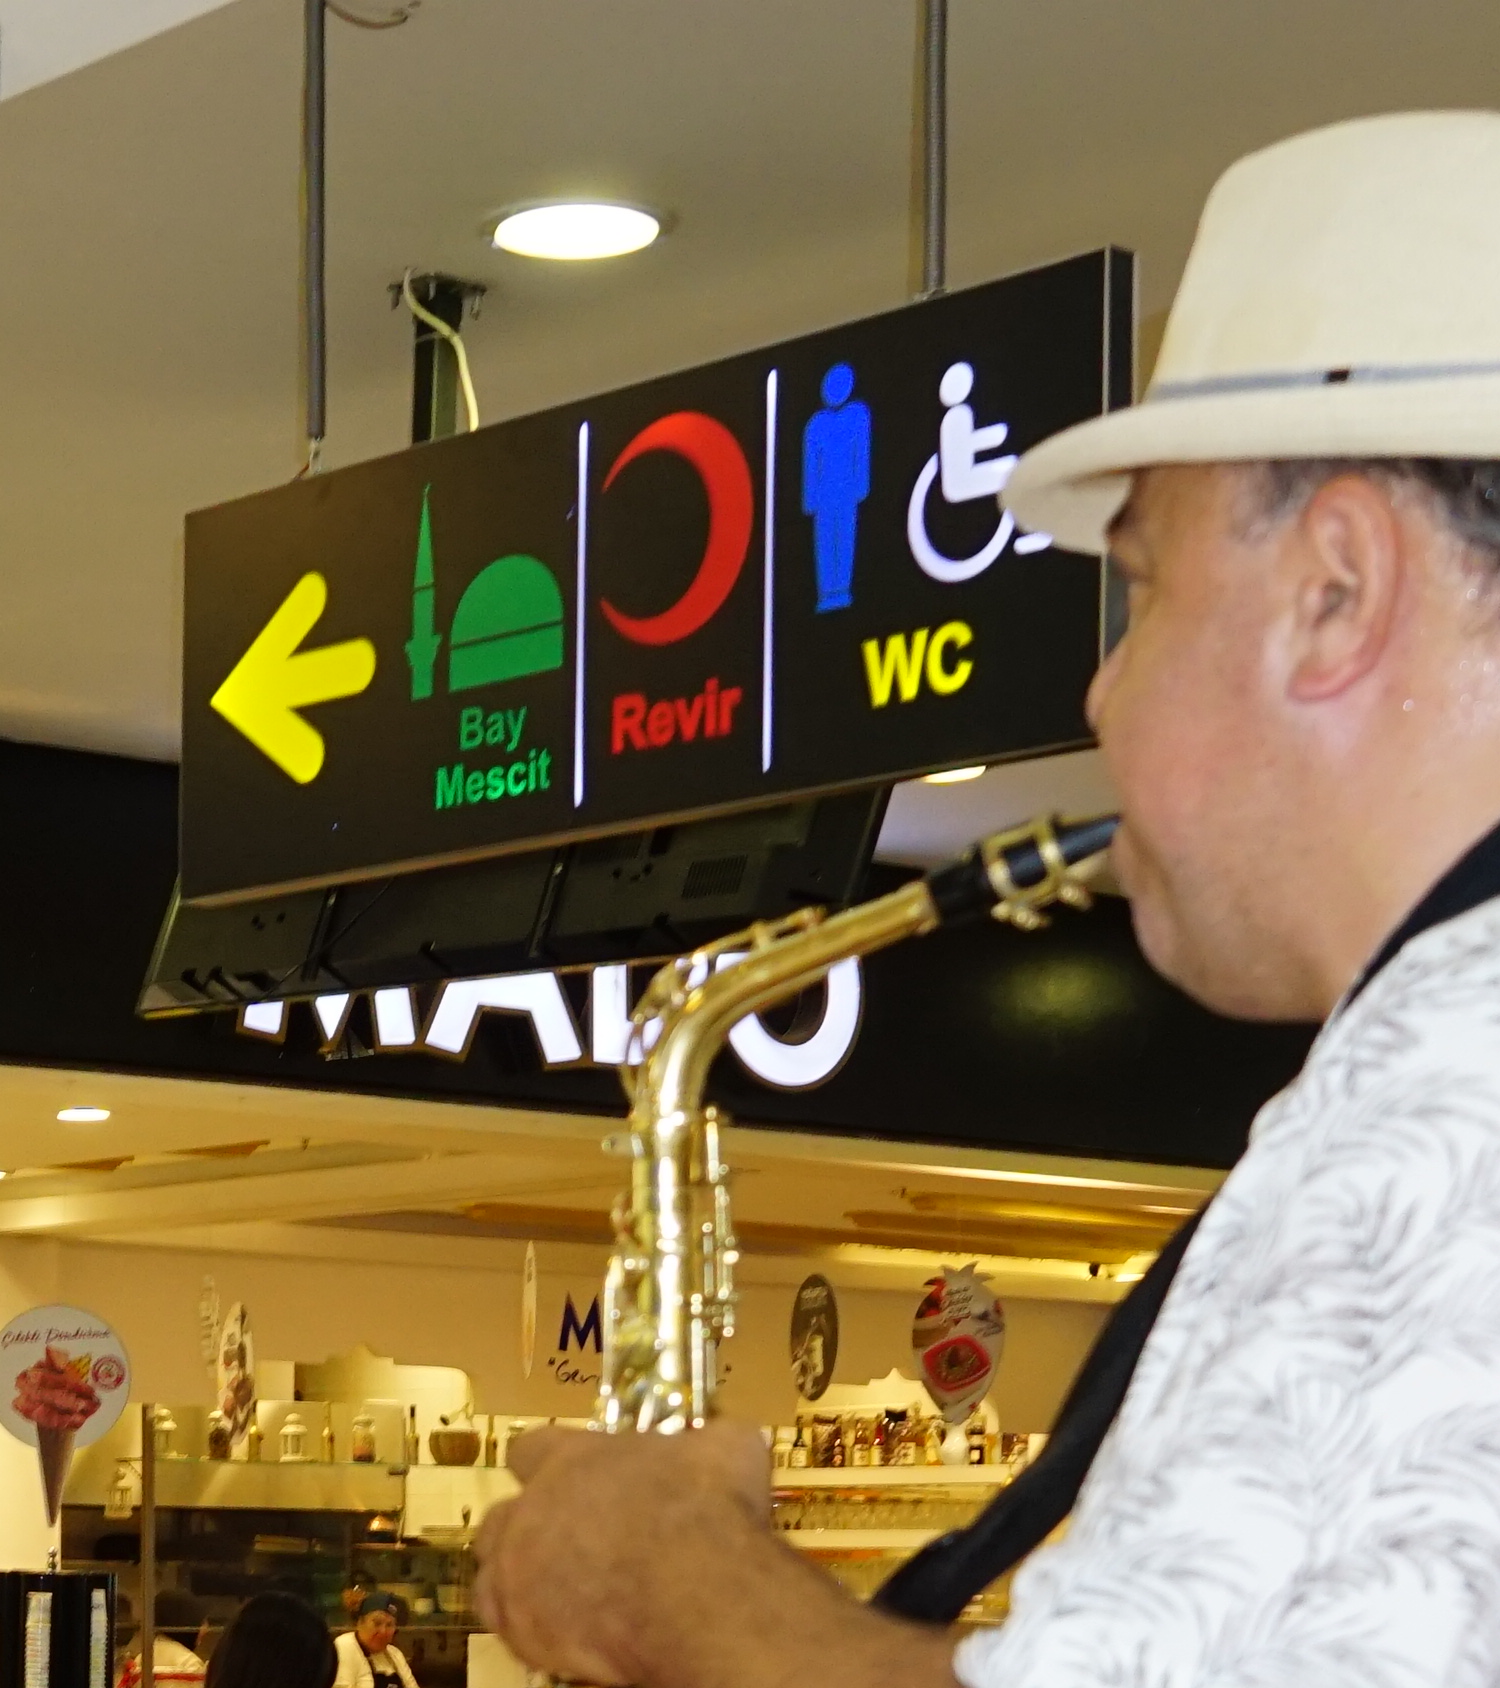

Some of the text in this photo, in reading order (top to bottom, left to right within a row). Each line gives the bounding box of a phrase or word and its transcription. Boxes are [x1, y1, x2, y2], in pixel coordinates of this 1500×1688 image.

[861, 620, 975, 709] WC
[459, 706, 528, 755] Bay
[610, 676, 743, 755] Revir
[434, 750, 552, 810] Mescit
